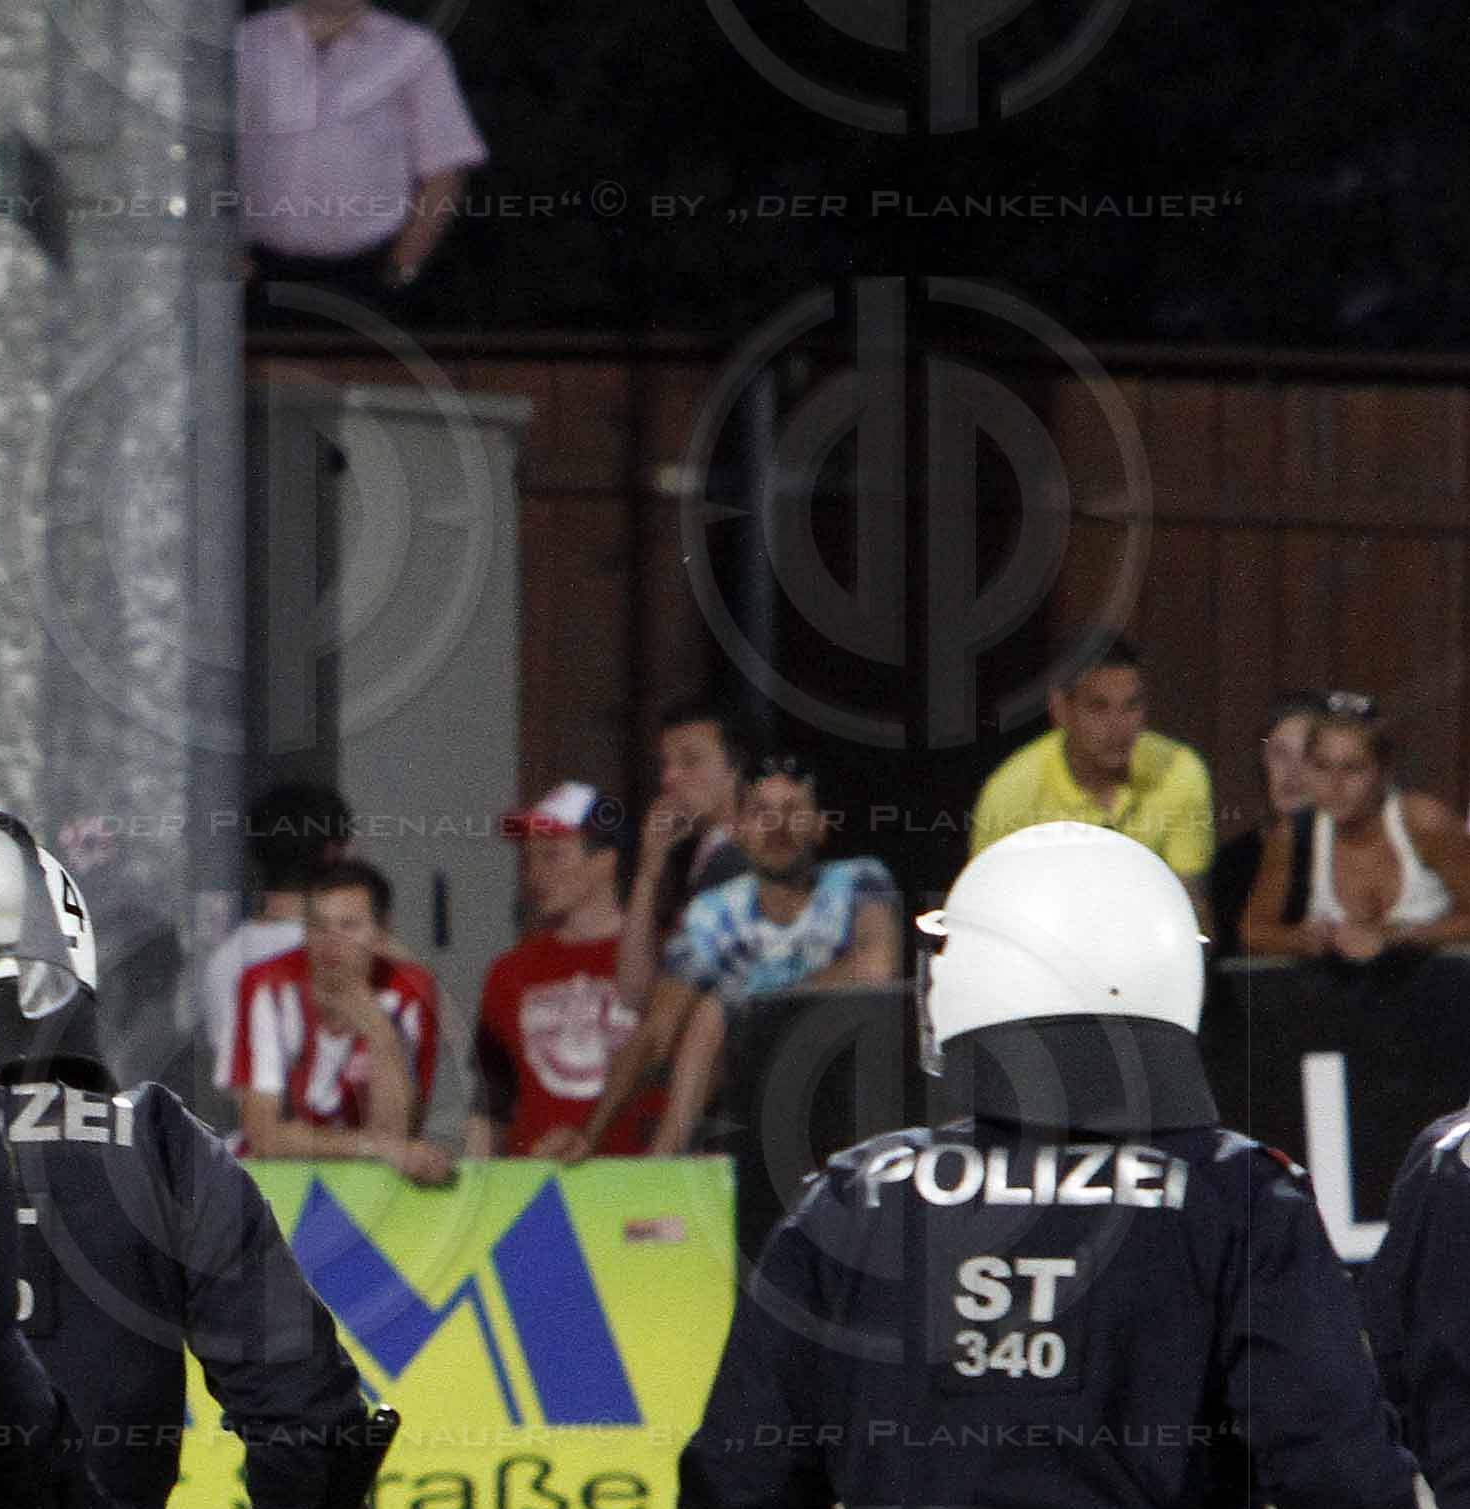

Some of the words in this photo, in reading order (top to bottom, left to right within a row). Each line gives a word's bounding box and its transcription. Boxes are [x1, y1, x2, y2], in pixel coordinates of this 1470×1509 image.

[863, 1144, 1189, 1210] POLIZEI
[953, 1254, 1077, 1323] ST
[953, 1329, 1067, 1379] 340
